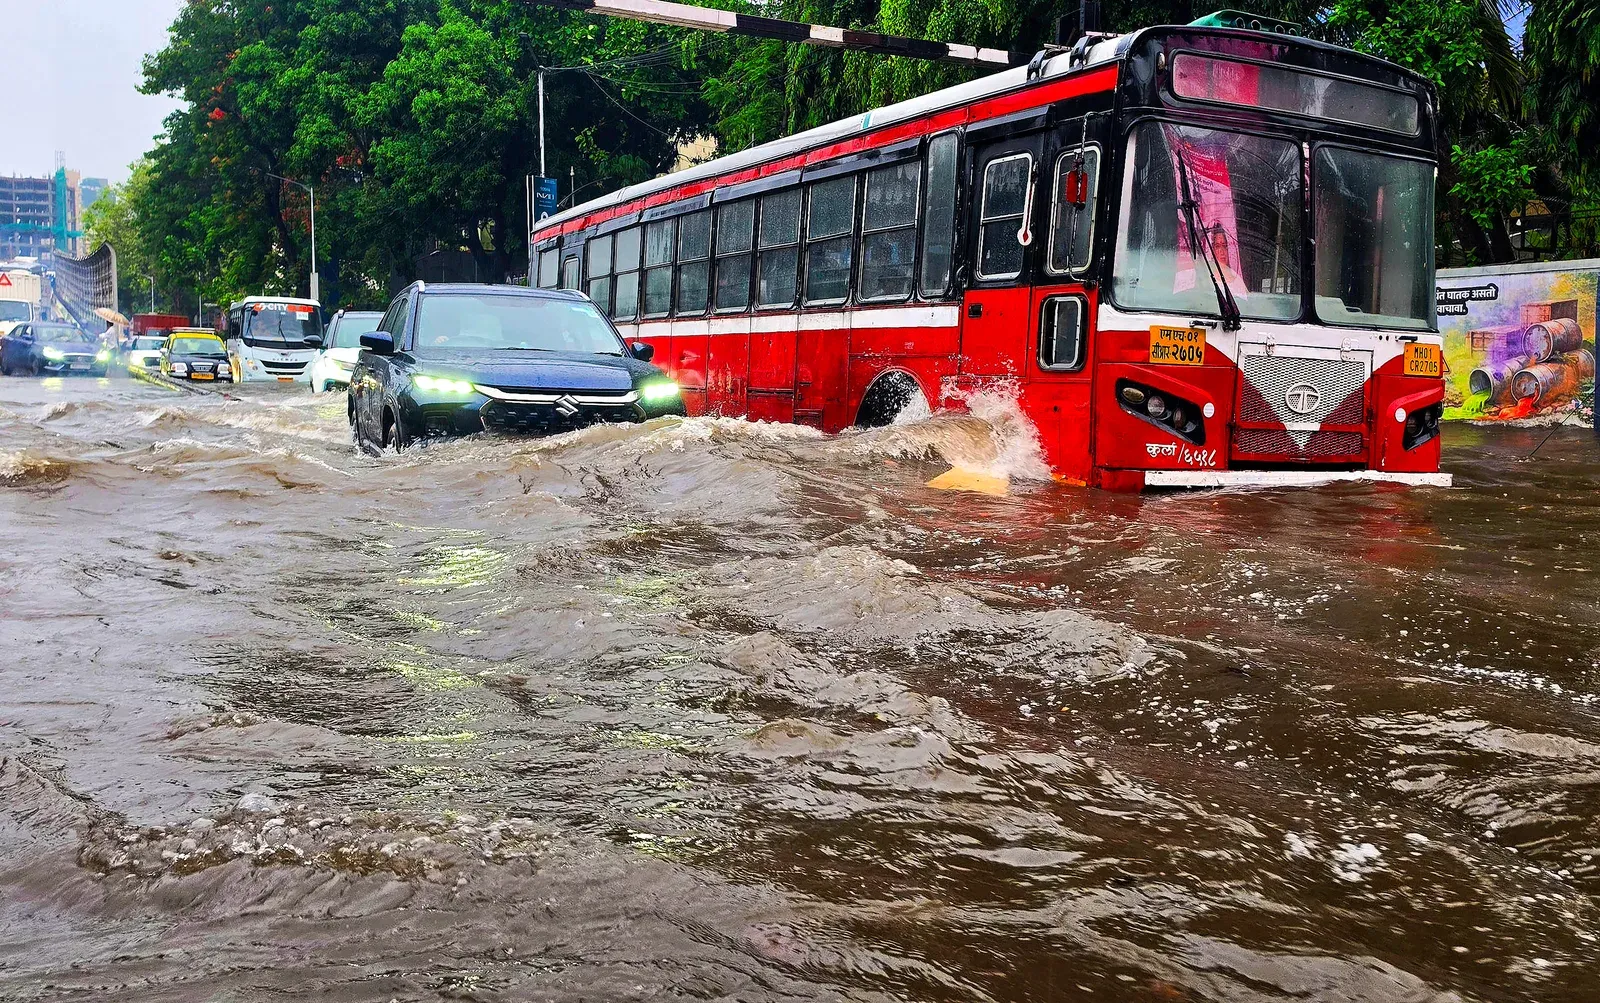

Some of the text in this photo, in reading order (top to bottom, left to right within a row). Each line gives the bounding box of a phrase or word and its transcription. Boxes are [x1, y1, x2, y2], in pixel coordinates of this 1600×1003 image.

[1447, 290, 1470, 300] घातक
[1471, 286, 1496, 298] असतो
[1414, 346, 1433, 359] MH01
[1409, 360, 1438, 372] CR2705
